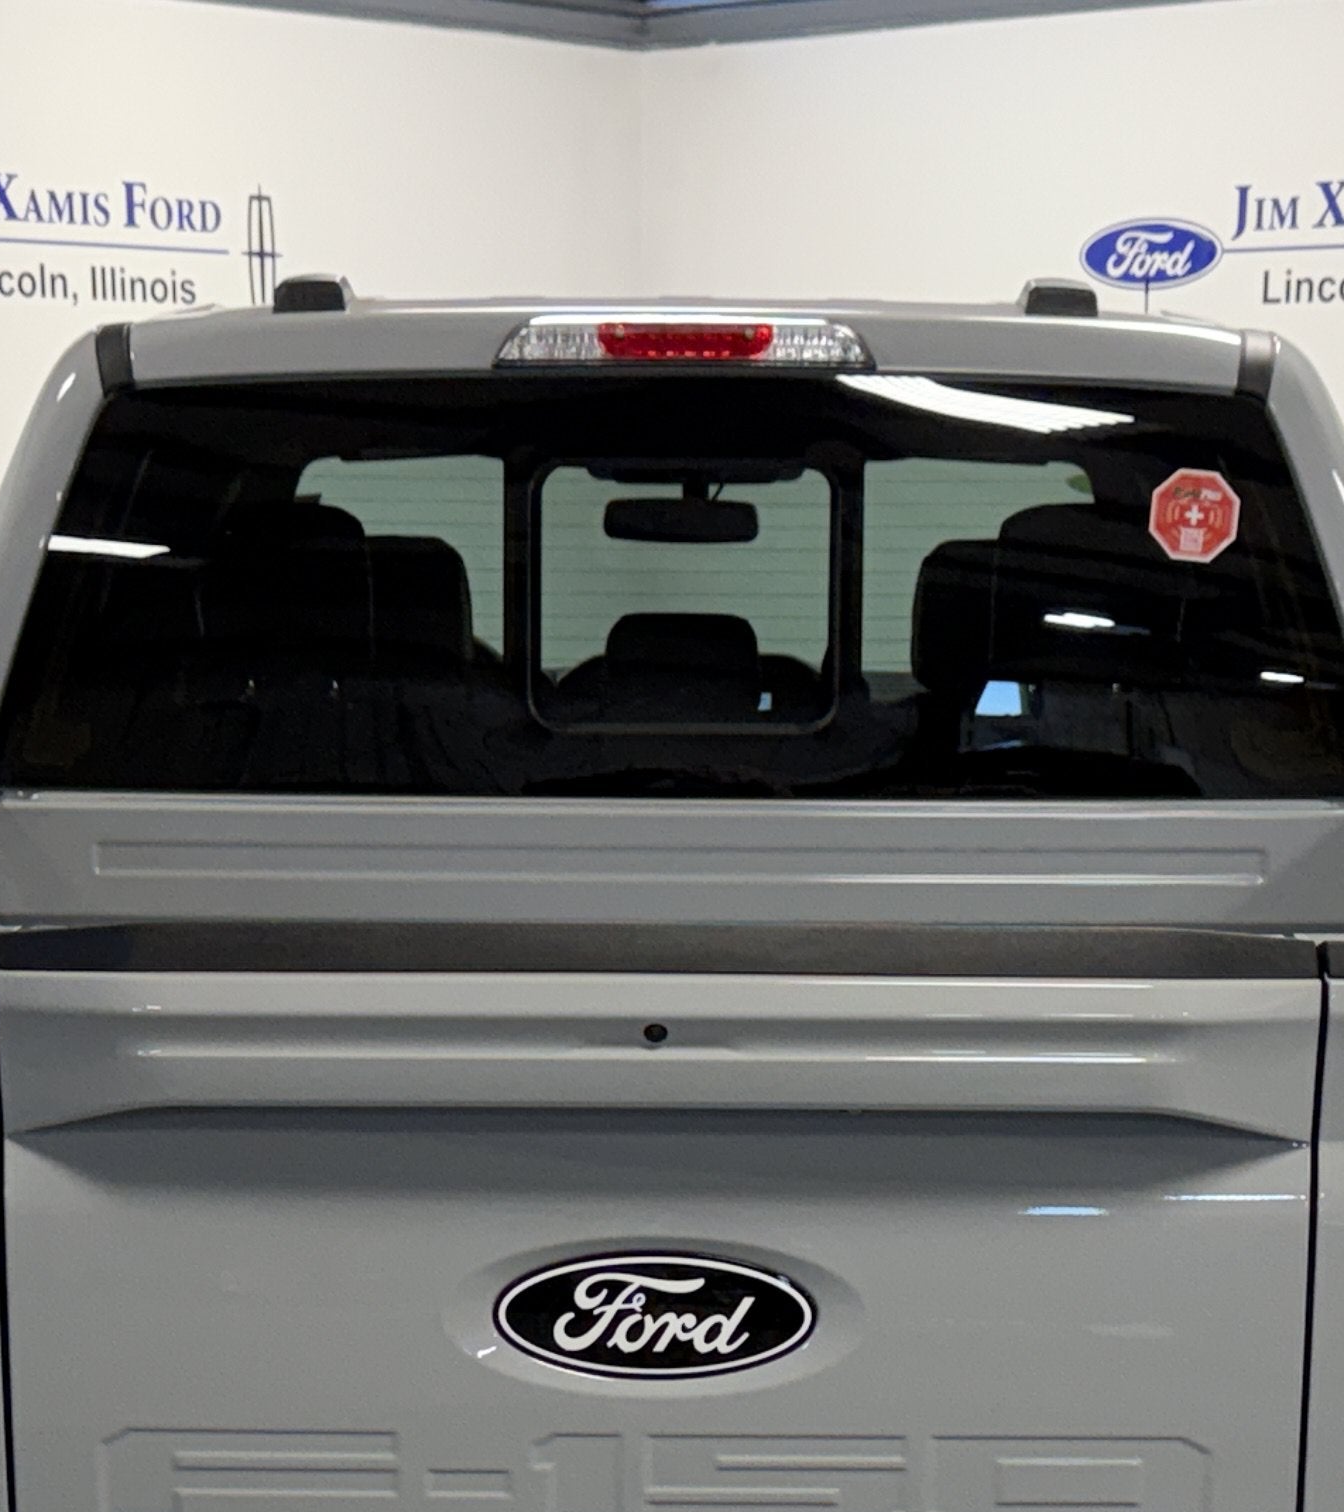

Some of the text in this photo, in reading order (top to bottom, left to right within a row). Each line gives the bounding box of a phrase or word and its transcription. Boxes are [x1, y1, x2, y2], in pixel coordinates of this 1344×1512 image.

[121, 180, 222, 234] FORD
[1232, 184, 1299, 241] JIM
[1106, 230, 1192, 278] Ford
[90, 265, 197, 305] Illinois
[552, 1271, 756, 1355] Ford
